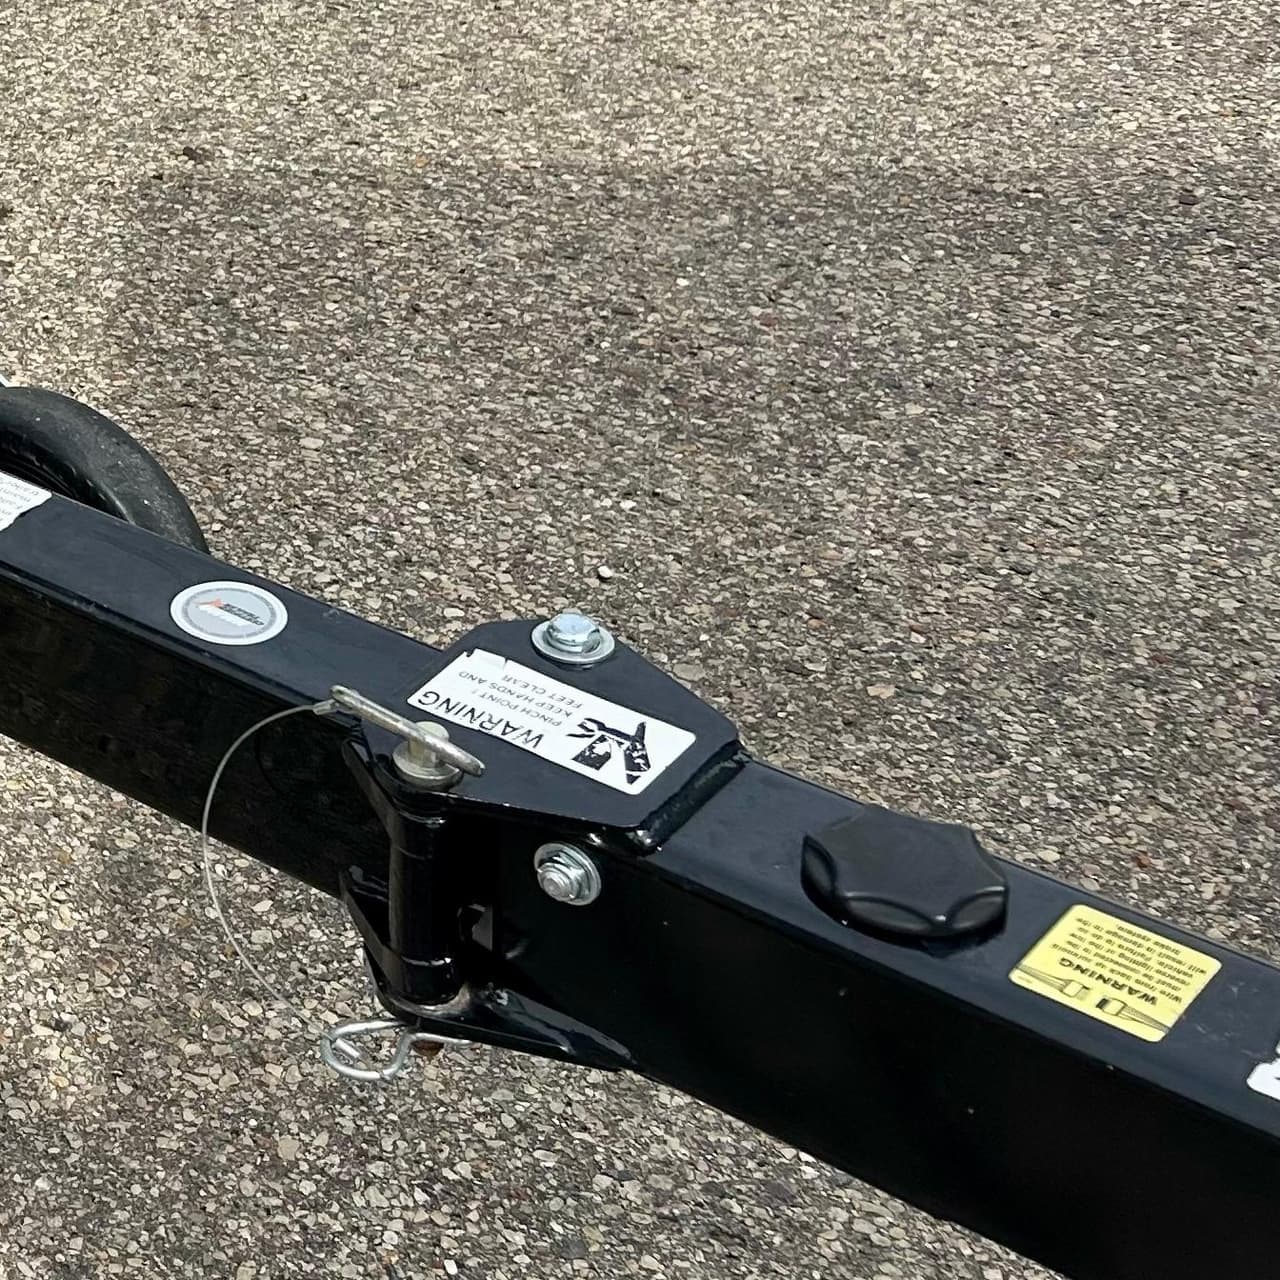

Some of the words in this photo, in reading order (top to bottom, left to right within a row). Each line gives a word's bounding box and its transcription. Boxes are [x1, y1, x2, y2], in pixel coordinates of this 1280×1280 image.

[458, 671, 487, 684] AND
[502, 675, 546, 694] CLEAR
[479, 692, 518, 709] POINT
[489, 682, 534, 702] HANDS
[548, 693, 582, 708] FEET
[418, 691, 544, 747] WARNING
[520, 707, 561, 726] PINCH
[535, 702, 572, 717] KEEP
[1059, 957, 1156, 1004] WARNING
